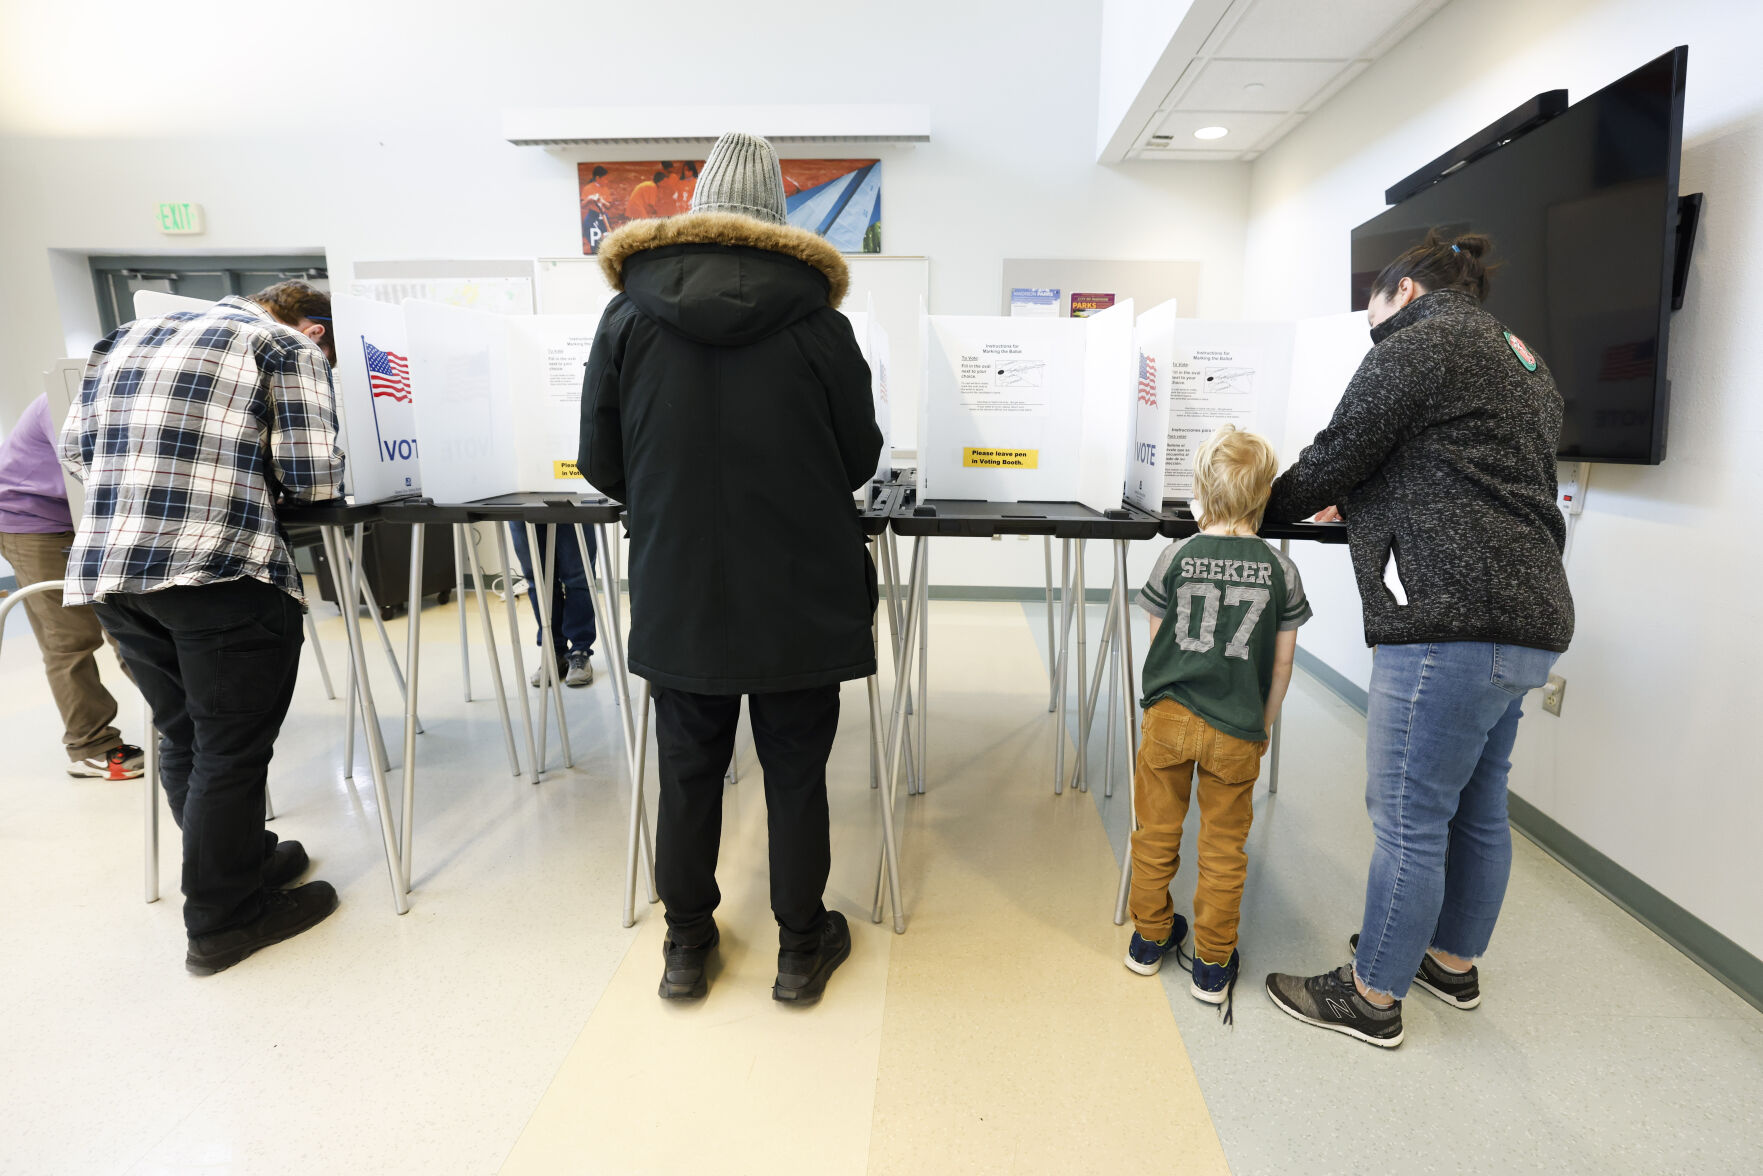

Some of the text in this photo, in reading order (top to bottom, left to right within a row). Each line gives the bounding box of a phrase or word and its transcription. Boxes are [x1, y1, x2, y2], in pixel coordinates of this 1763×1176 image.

[160, 203, 192, 230] EXIT
[384, 439, 419, 461] VOT
[1136, 441, 1156, 467] VOTE
[1181, 557, 1272, 585] SEEKER
[1175, 581, 1271, 661] 07
